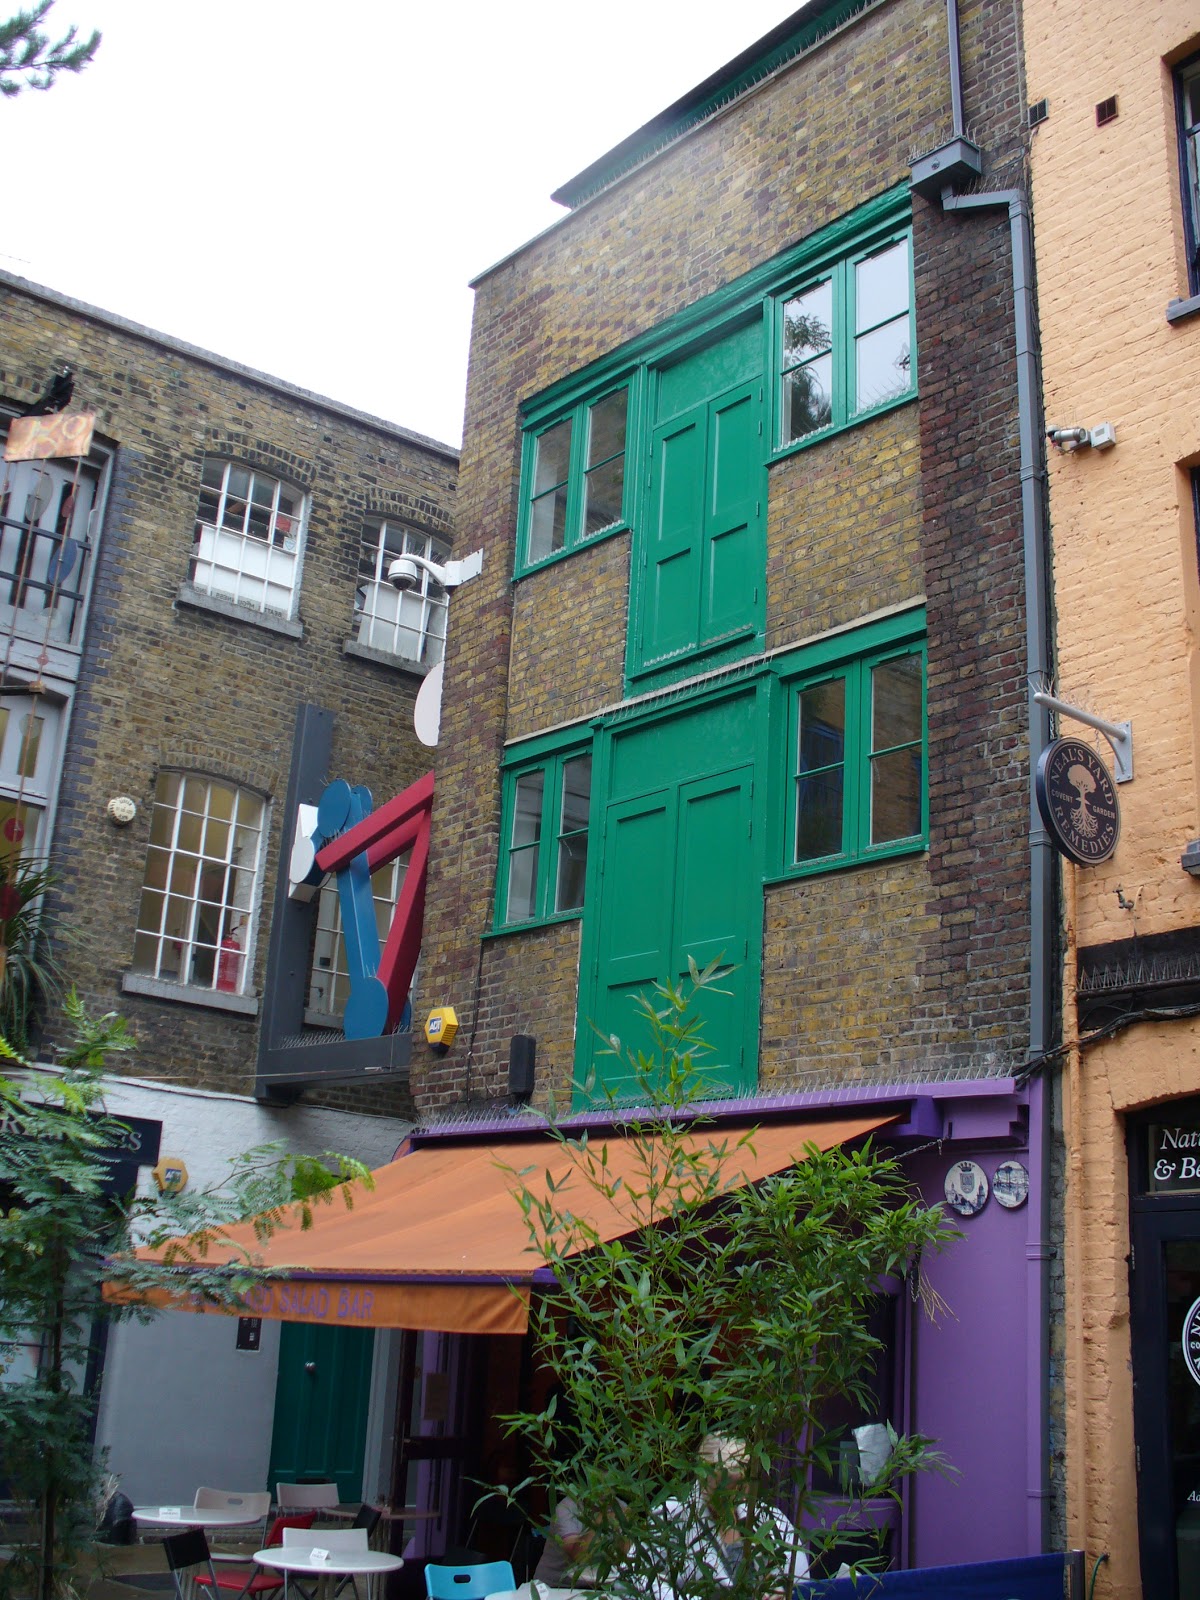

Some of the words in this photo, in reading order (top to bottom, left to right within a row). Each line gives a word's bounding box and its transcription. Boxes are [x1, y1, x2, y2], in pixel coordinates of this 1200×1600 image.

[1050, 748, 1084, 784] NEAL'S
[1088, 755, 1114, 805] YARD
[1051, 789, 1074, 803] COVENT
[1092, 805, 1116, 819] GARDEN
[1055, 806, 1114, 854] REMEDIES
[429, 1019, 442, 1031] ADT
[1154, 1159, 1176, 1180] &
[278, 1285, 329, 1318] SALAD
[337, 1286, 375, 1319] BAR
